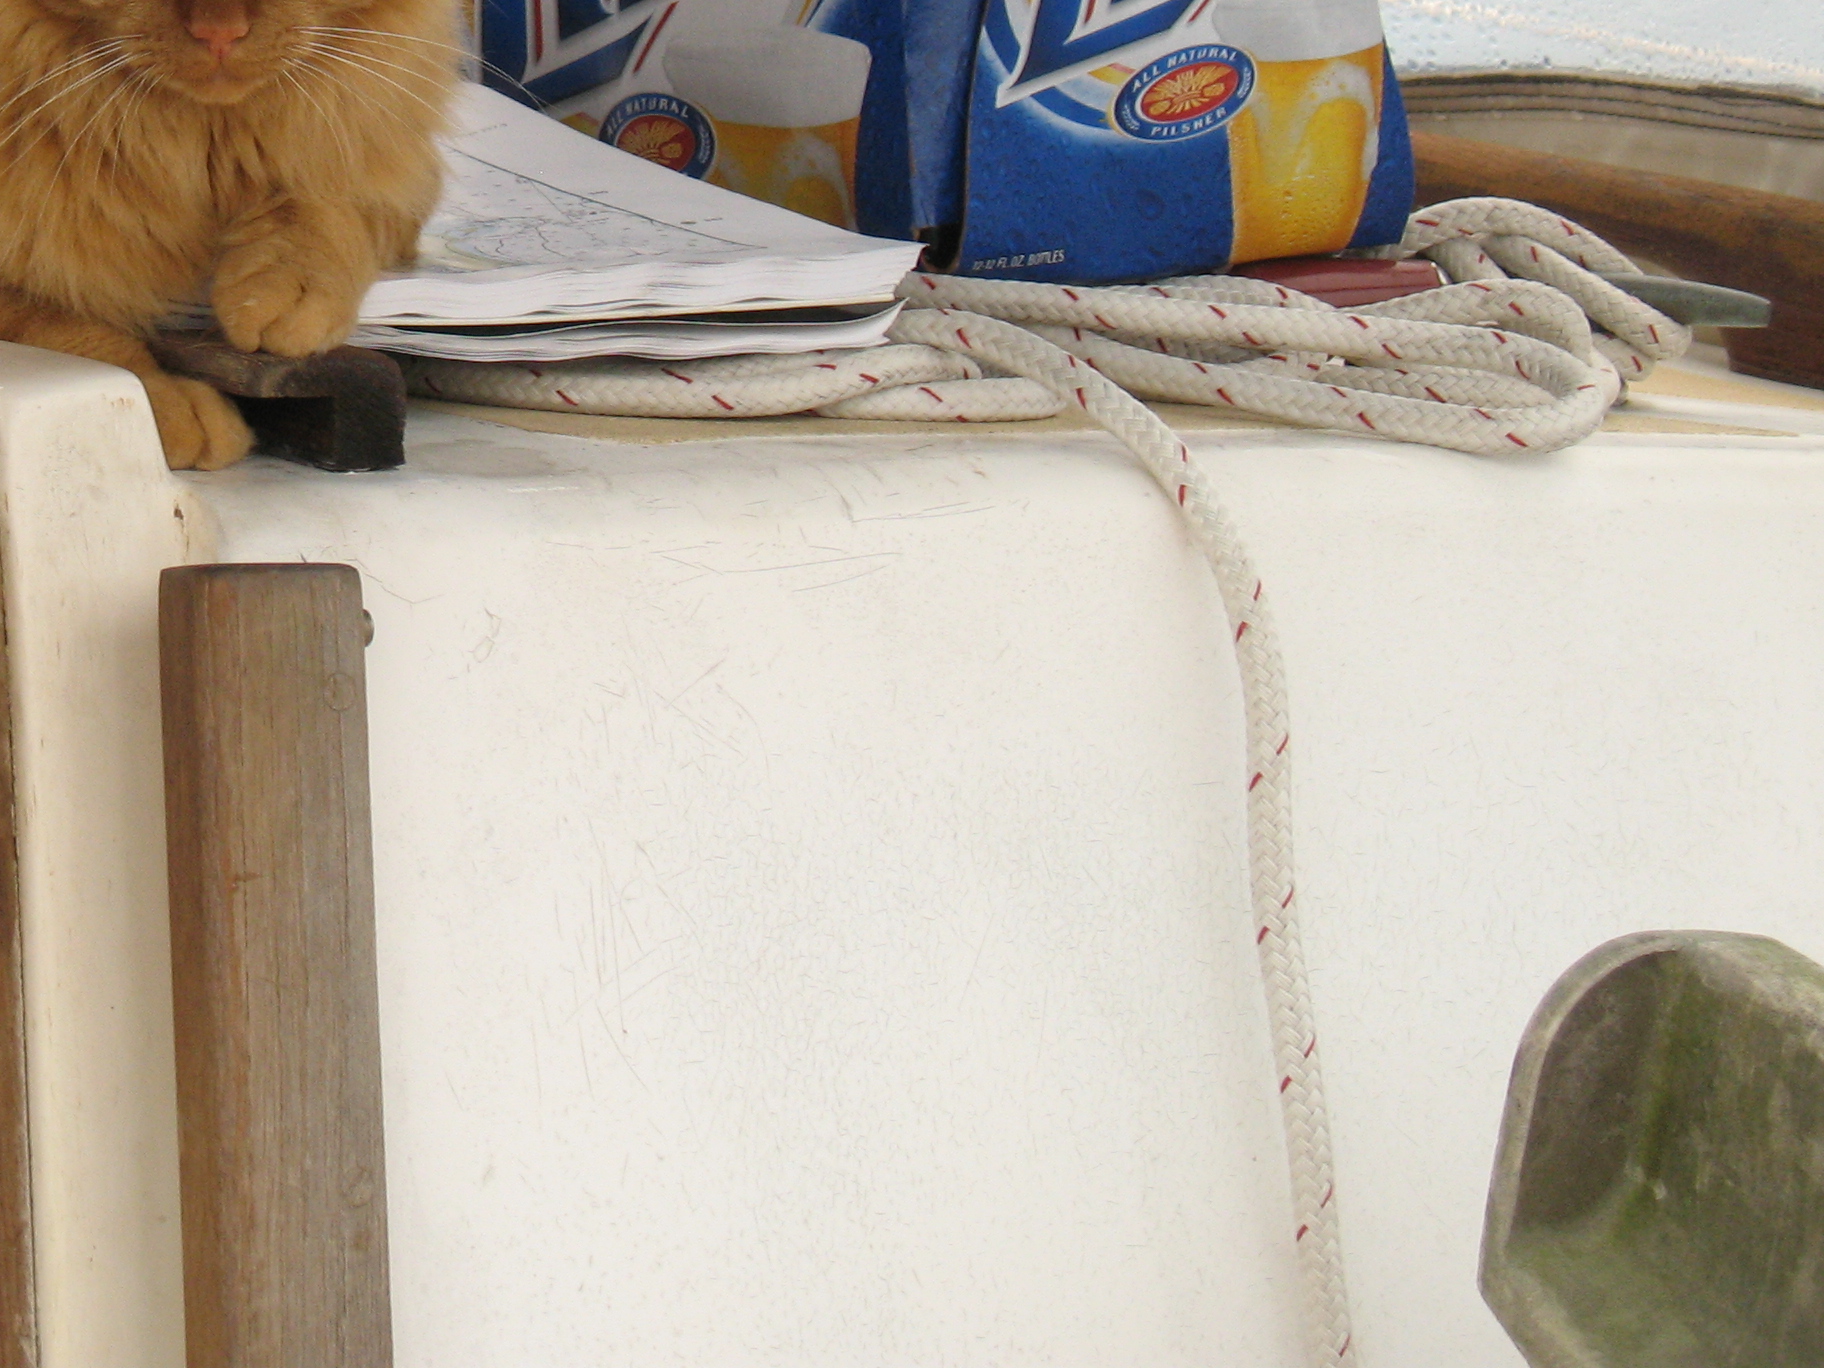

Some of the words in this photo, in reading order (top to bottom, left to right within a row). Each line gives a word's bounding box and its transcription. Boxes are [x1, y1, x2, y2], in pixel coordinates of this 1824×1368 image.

[1132, 65, 1162, 93] ALL
[1167, 47, 1238, 69] NATURAL
[626, 97, 690, 118] NATURAL
[1150, 107, 1227, 137] PILSNER
